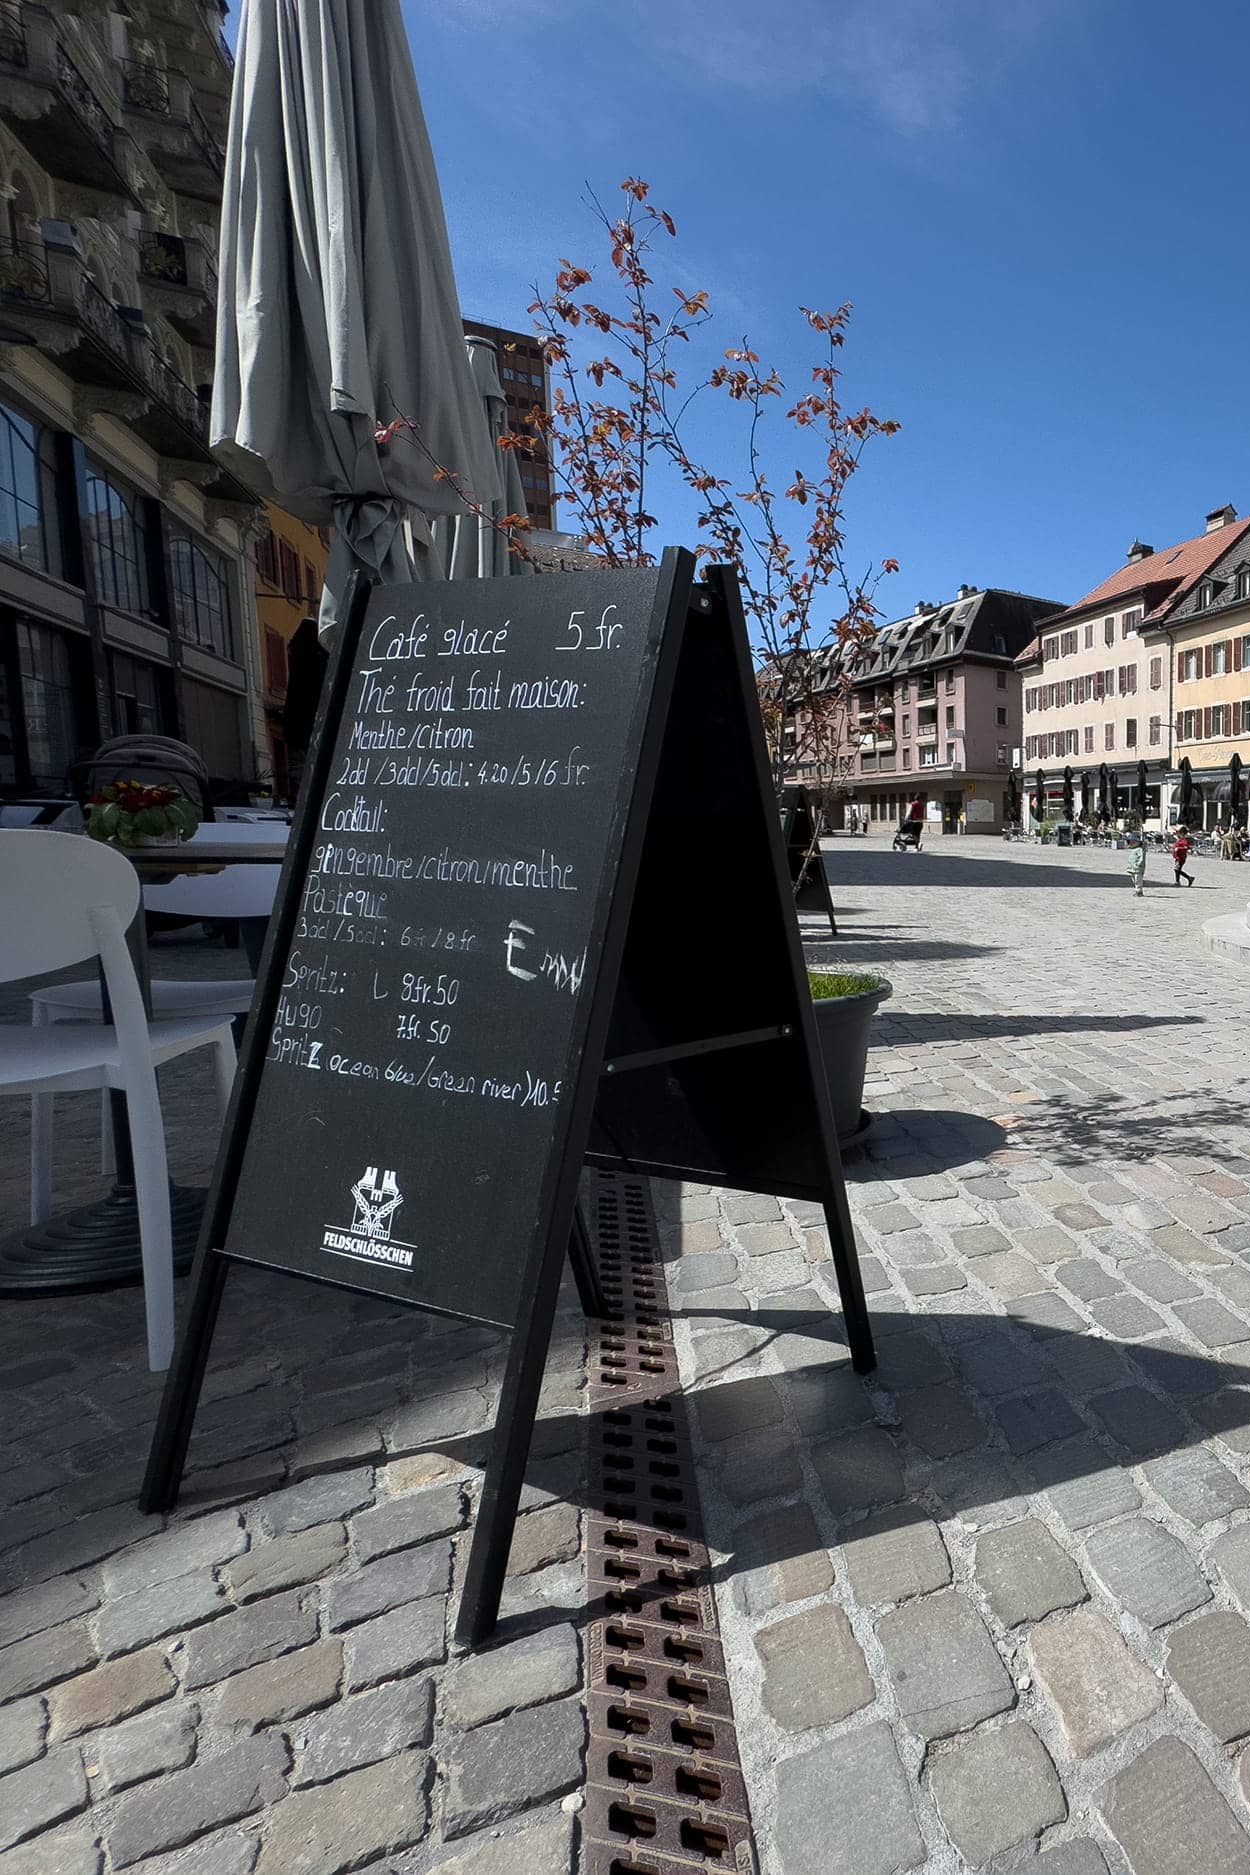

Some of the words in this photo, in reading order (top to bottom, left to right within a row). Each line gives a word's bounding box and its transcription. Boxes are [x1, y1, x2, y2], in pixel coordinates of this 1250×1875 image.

[369, 614, 430, 660] Café
[437, 619, 511, 656] glacé
[555, 611, 585, 650] 5
[585, 605, 623, 650] fr.
[356, 667, 397, 714] Thé
[406, 672, 455, 712] froid
[461, 669, 501, 711] fait
[507, 675, 587, 709] maison:
[282, 950, 347, 994] Spritz:
[323, 1231, 414, 1266] FELDSCHLÖSSCHEN
